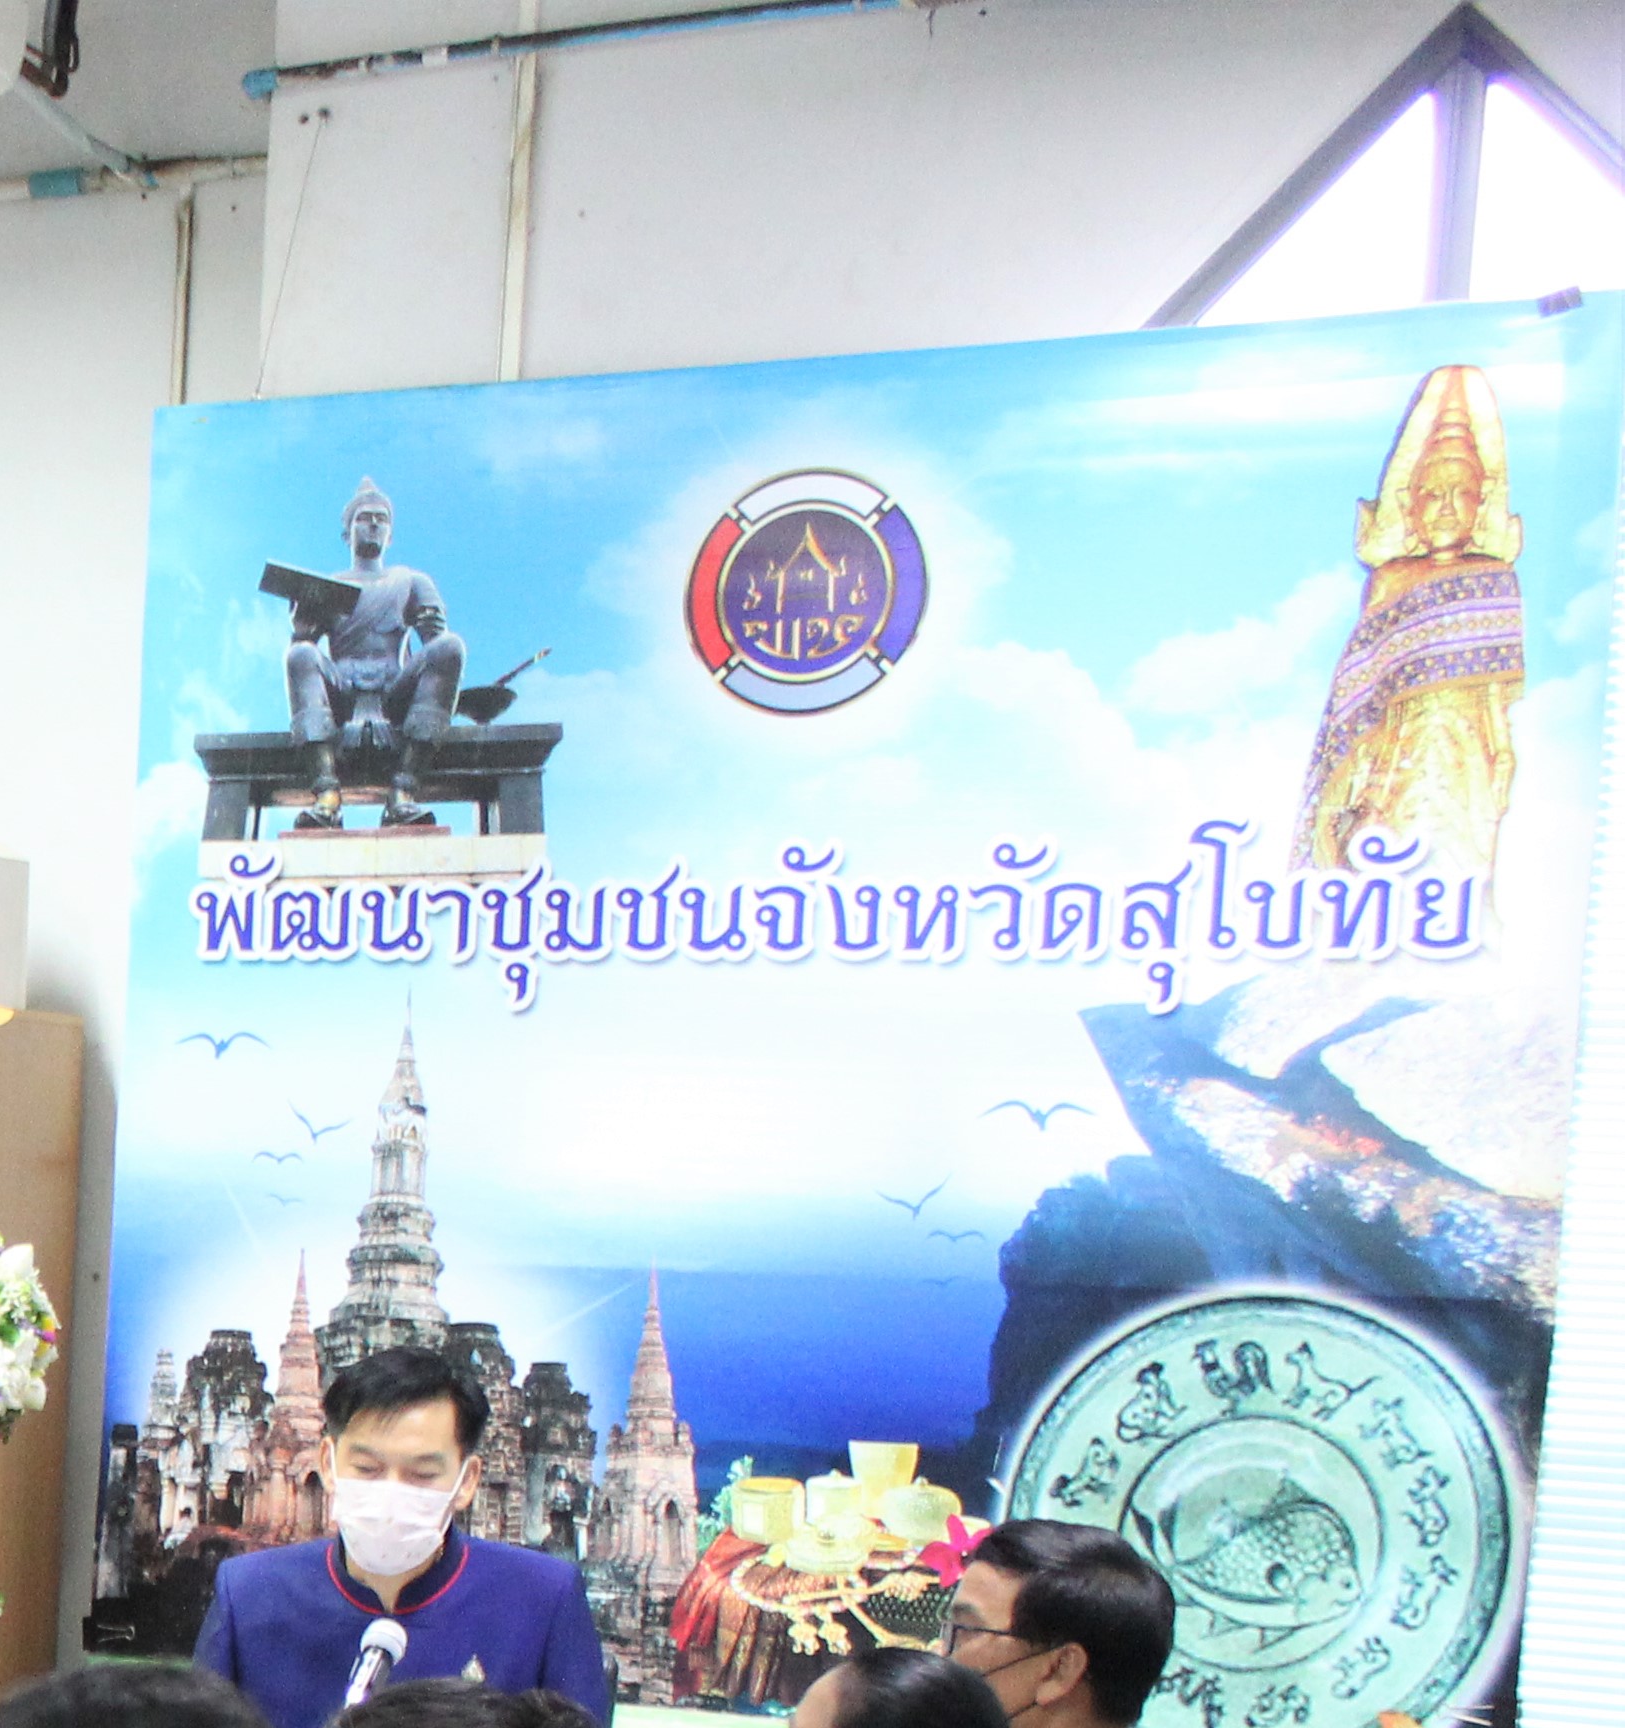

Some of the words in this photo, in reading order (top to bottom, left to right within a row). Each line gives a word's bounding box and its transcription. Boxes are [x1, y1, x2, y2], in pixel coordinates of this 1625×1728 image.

[193, 817, 1476, 1006] พัฒนาชุมชนจังหวัดสุโขทัย
